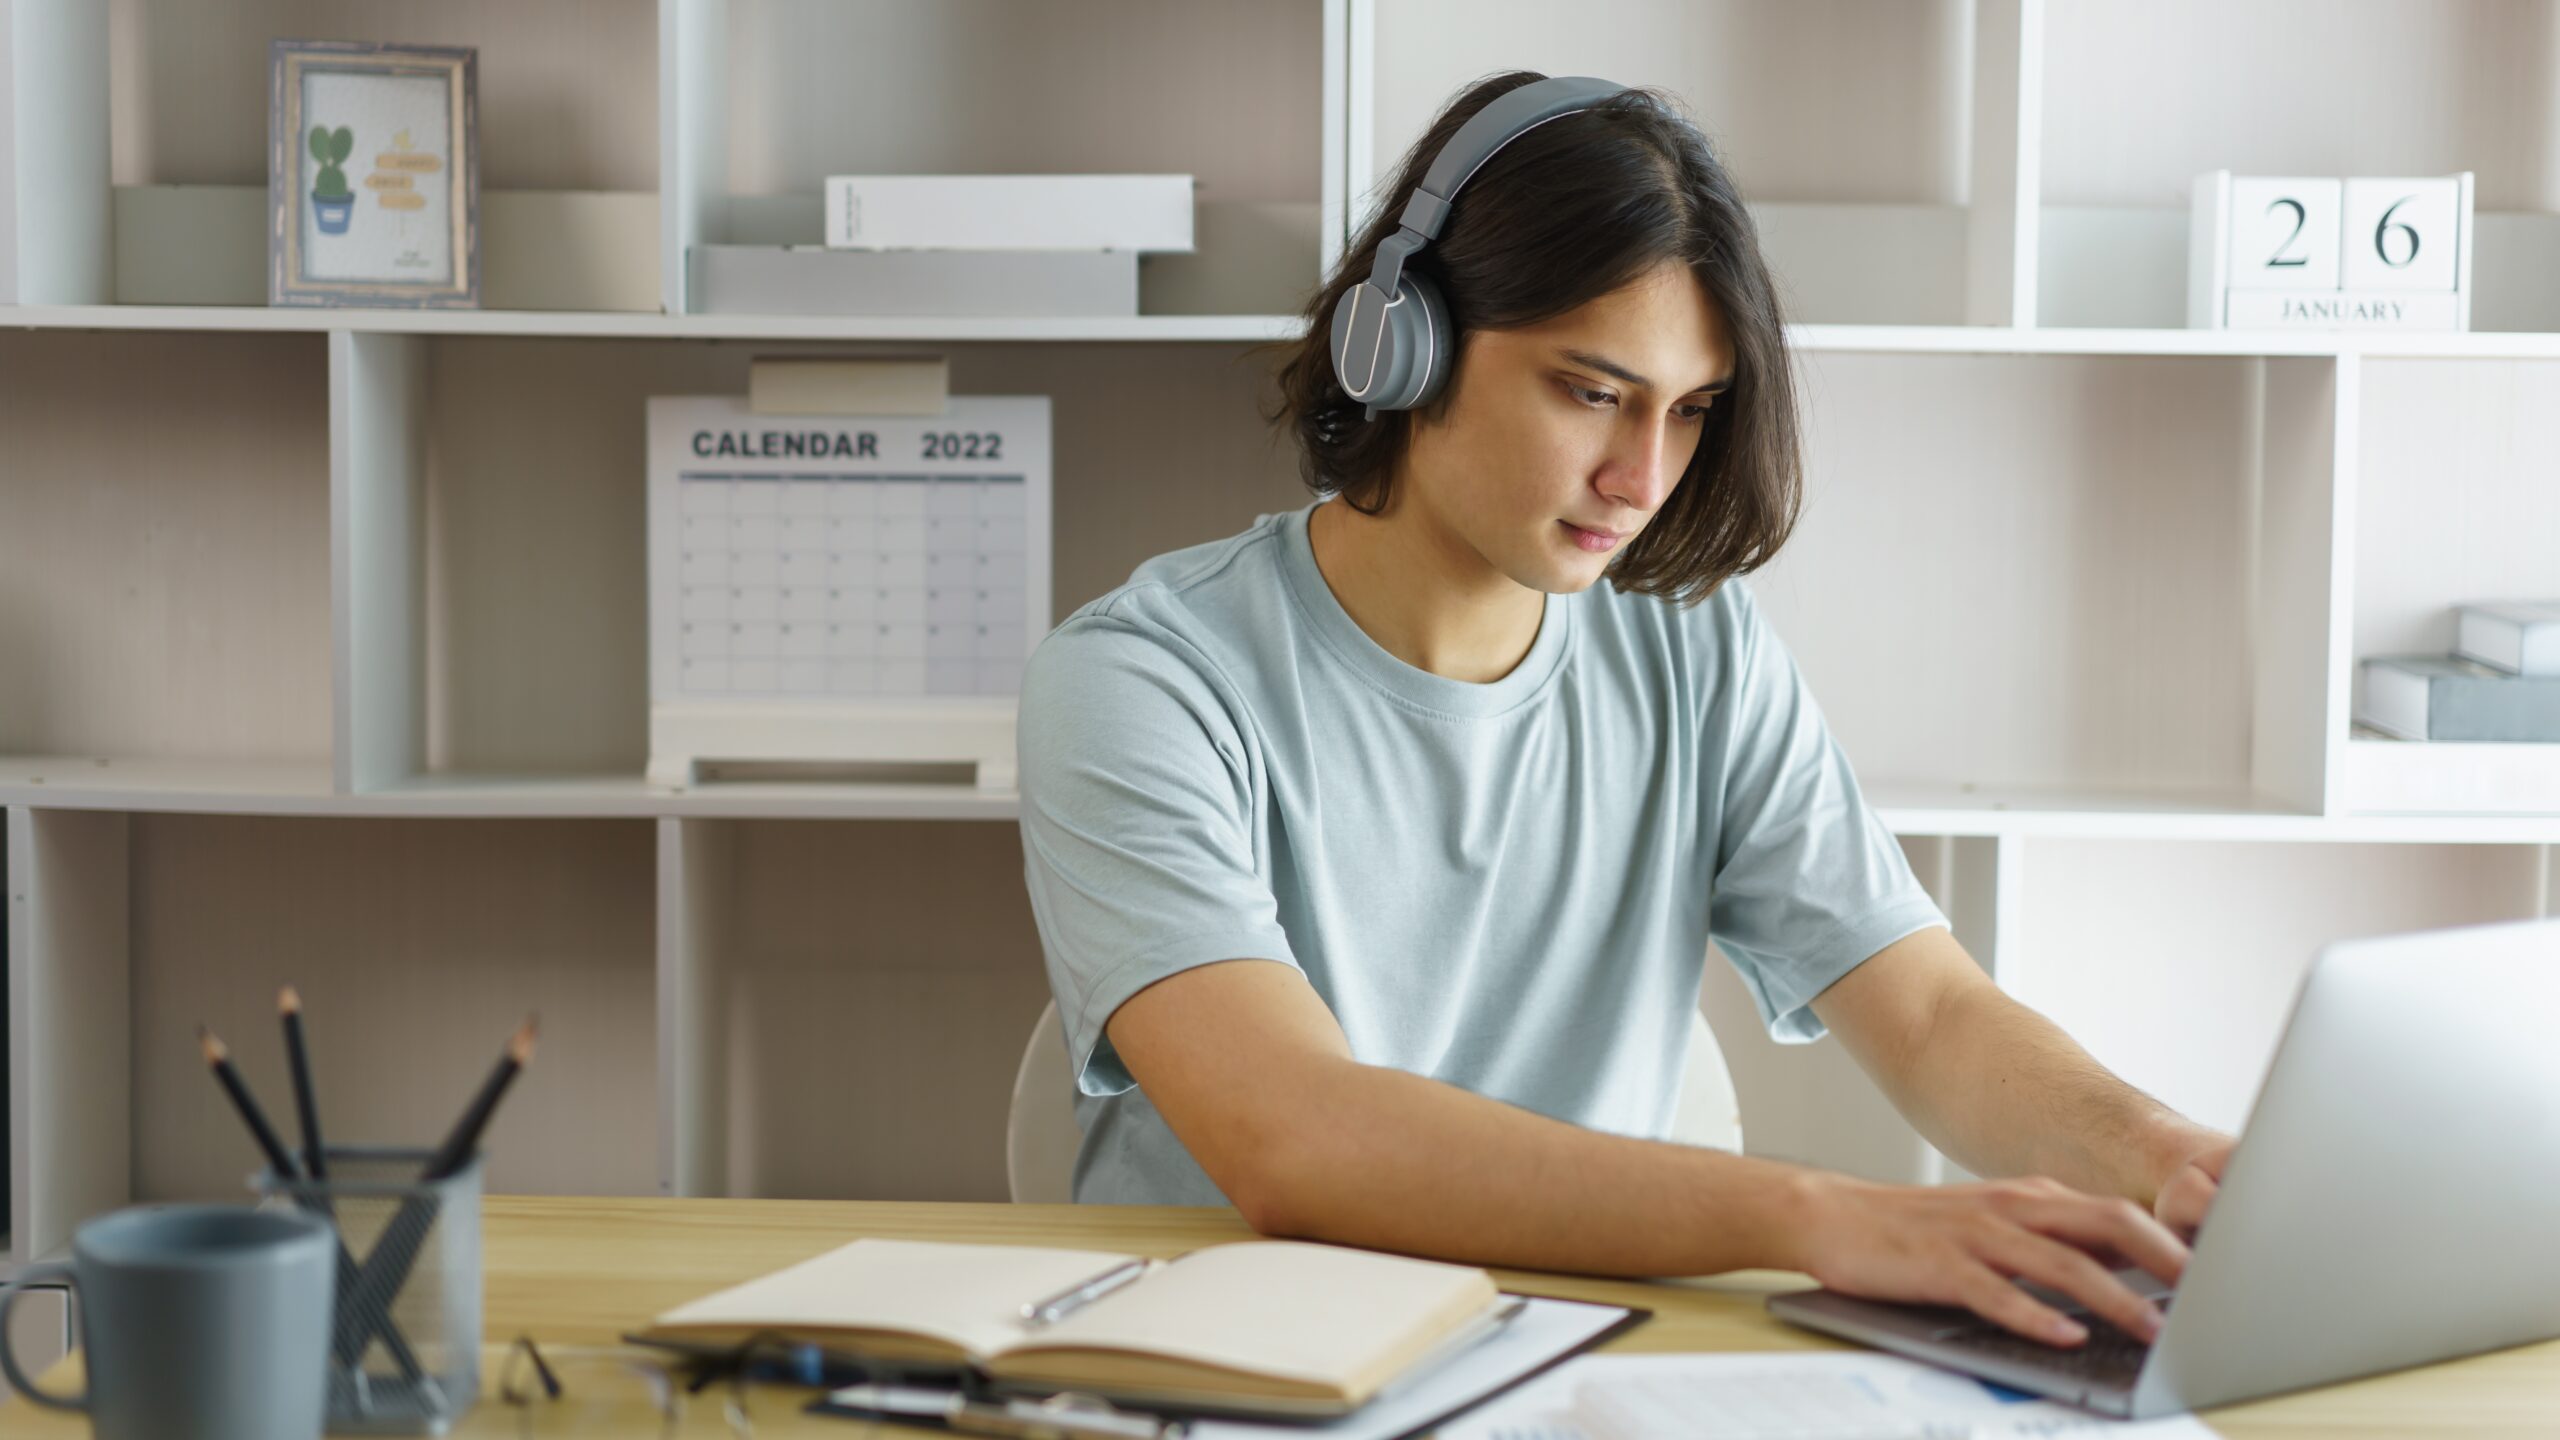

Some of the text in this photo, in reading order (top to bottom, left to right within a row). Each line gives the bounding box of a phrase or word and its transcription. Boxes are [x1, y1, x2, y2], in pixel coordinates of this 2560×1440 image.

[2264, 194, 2421, 269] 2 6
[2280, 299, 2407, 321] JANUARY
[691, 430, 1003, 460] CALENDAR 2022
